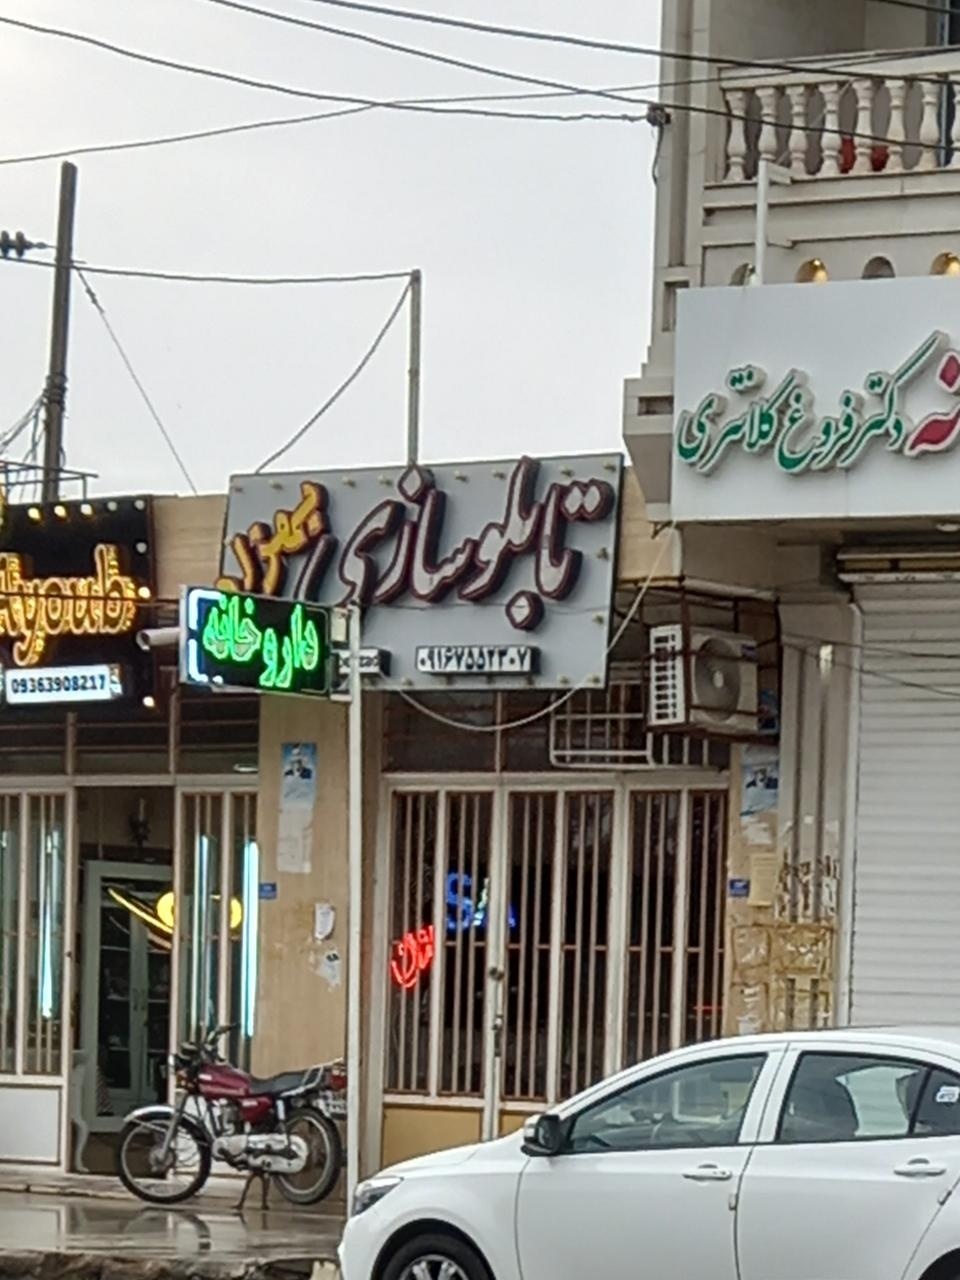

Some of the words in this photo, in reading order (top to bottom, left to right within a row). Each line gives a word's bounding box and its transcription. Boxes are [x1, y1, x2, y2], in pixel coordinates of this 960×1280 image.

[677, 364, 800, 474] کلانتری
[776, 387, 862, 474] فروغ
[838, 331, 948, 469] دکتر
[203, 596, 318, 687] داروخانه
